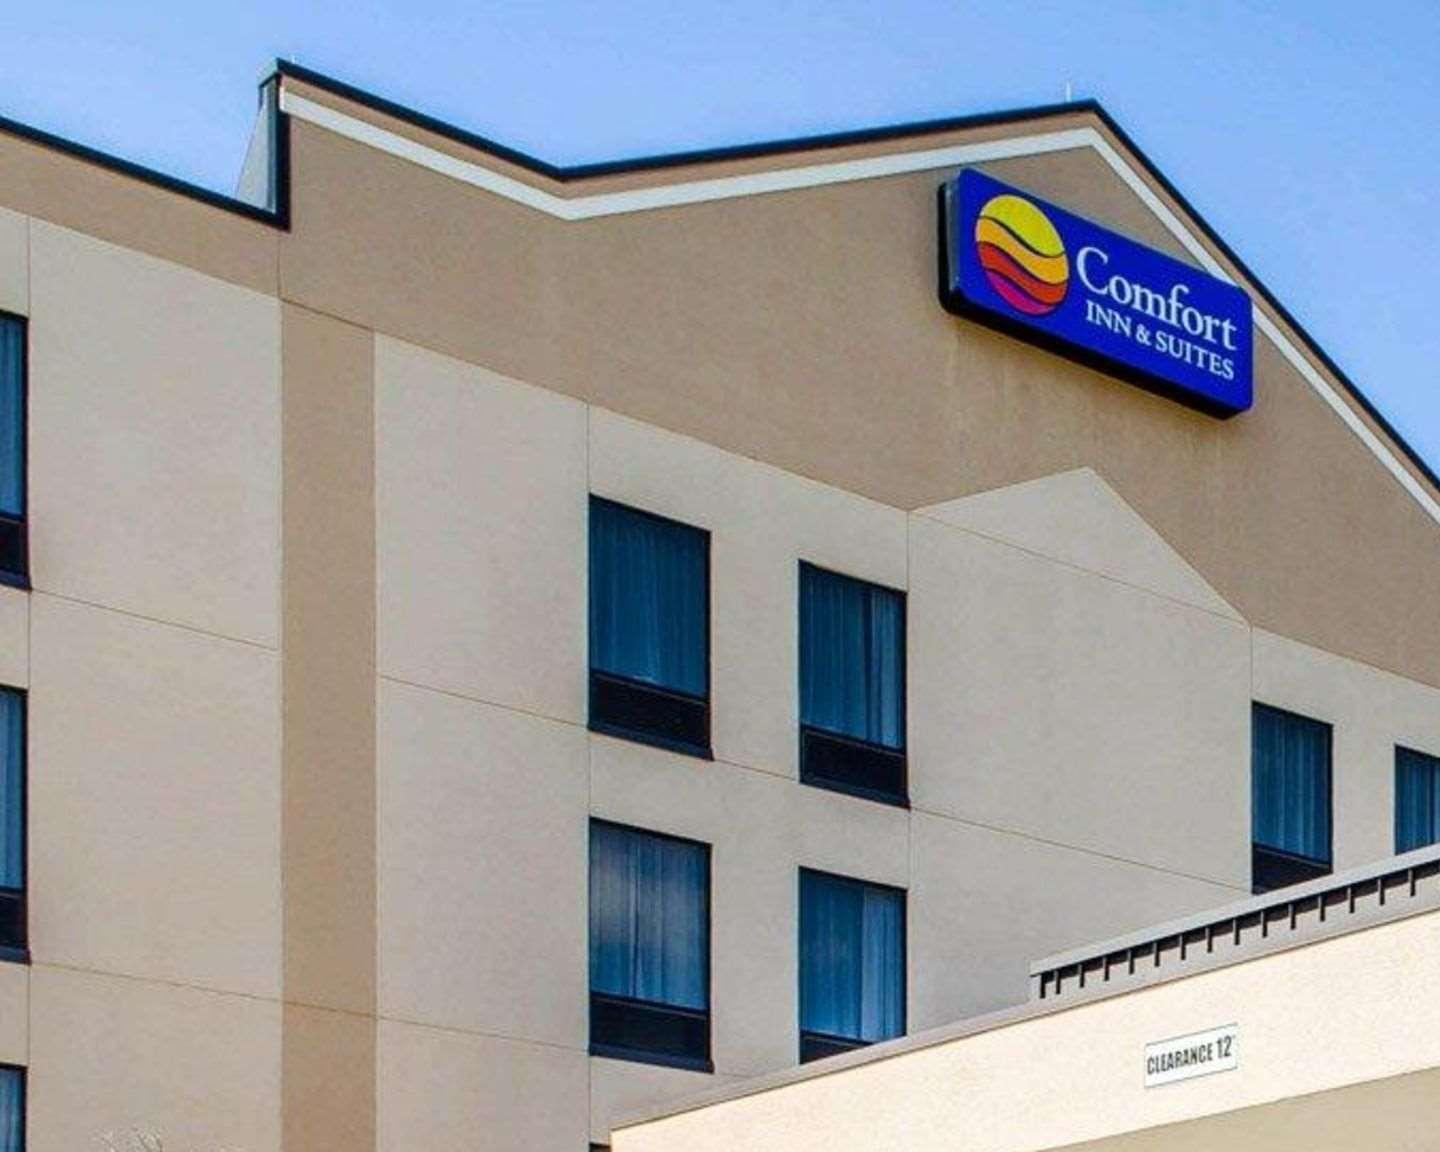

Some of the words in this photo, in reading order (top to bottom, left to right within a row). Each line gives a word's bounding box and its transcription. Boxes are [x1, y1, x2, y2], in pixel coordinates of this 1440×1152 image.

[1075, 245, 1238, 351] Comfort
[1085, 299, 1132, 339] INN
[1136, 324, 1152, 347] &
[1155, 331, 1235, 381] SUITES
[1147, 1042, 1213, 1075] CLEARANCE
